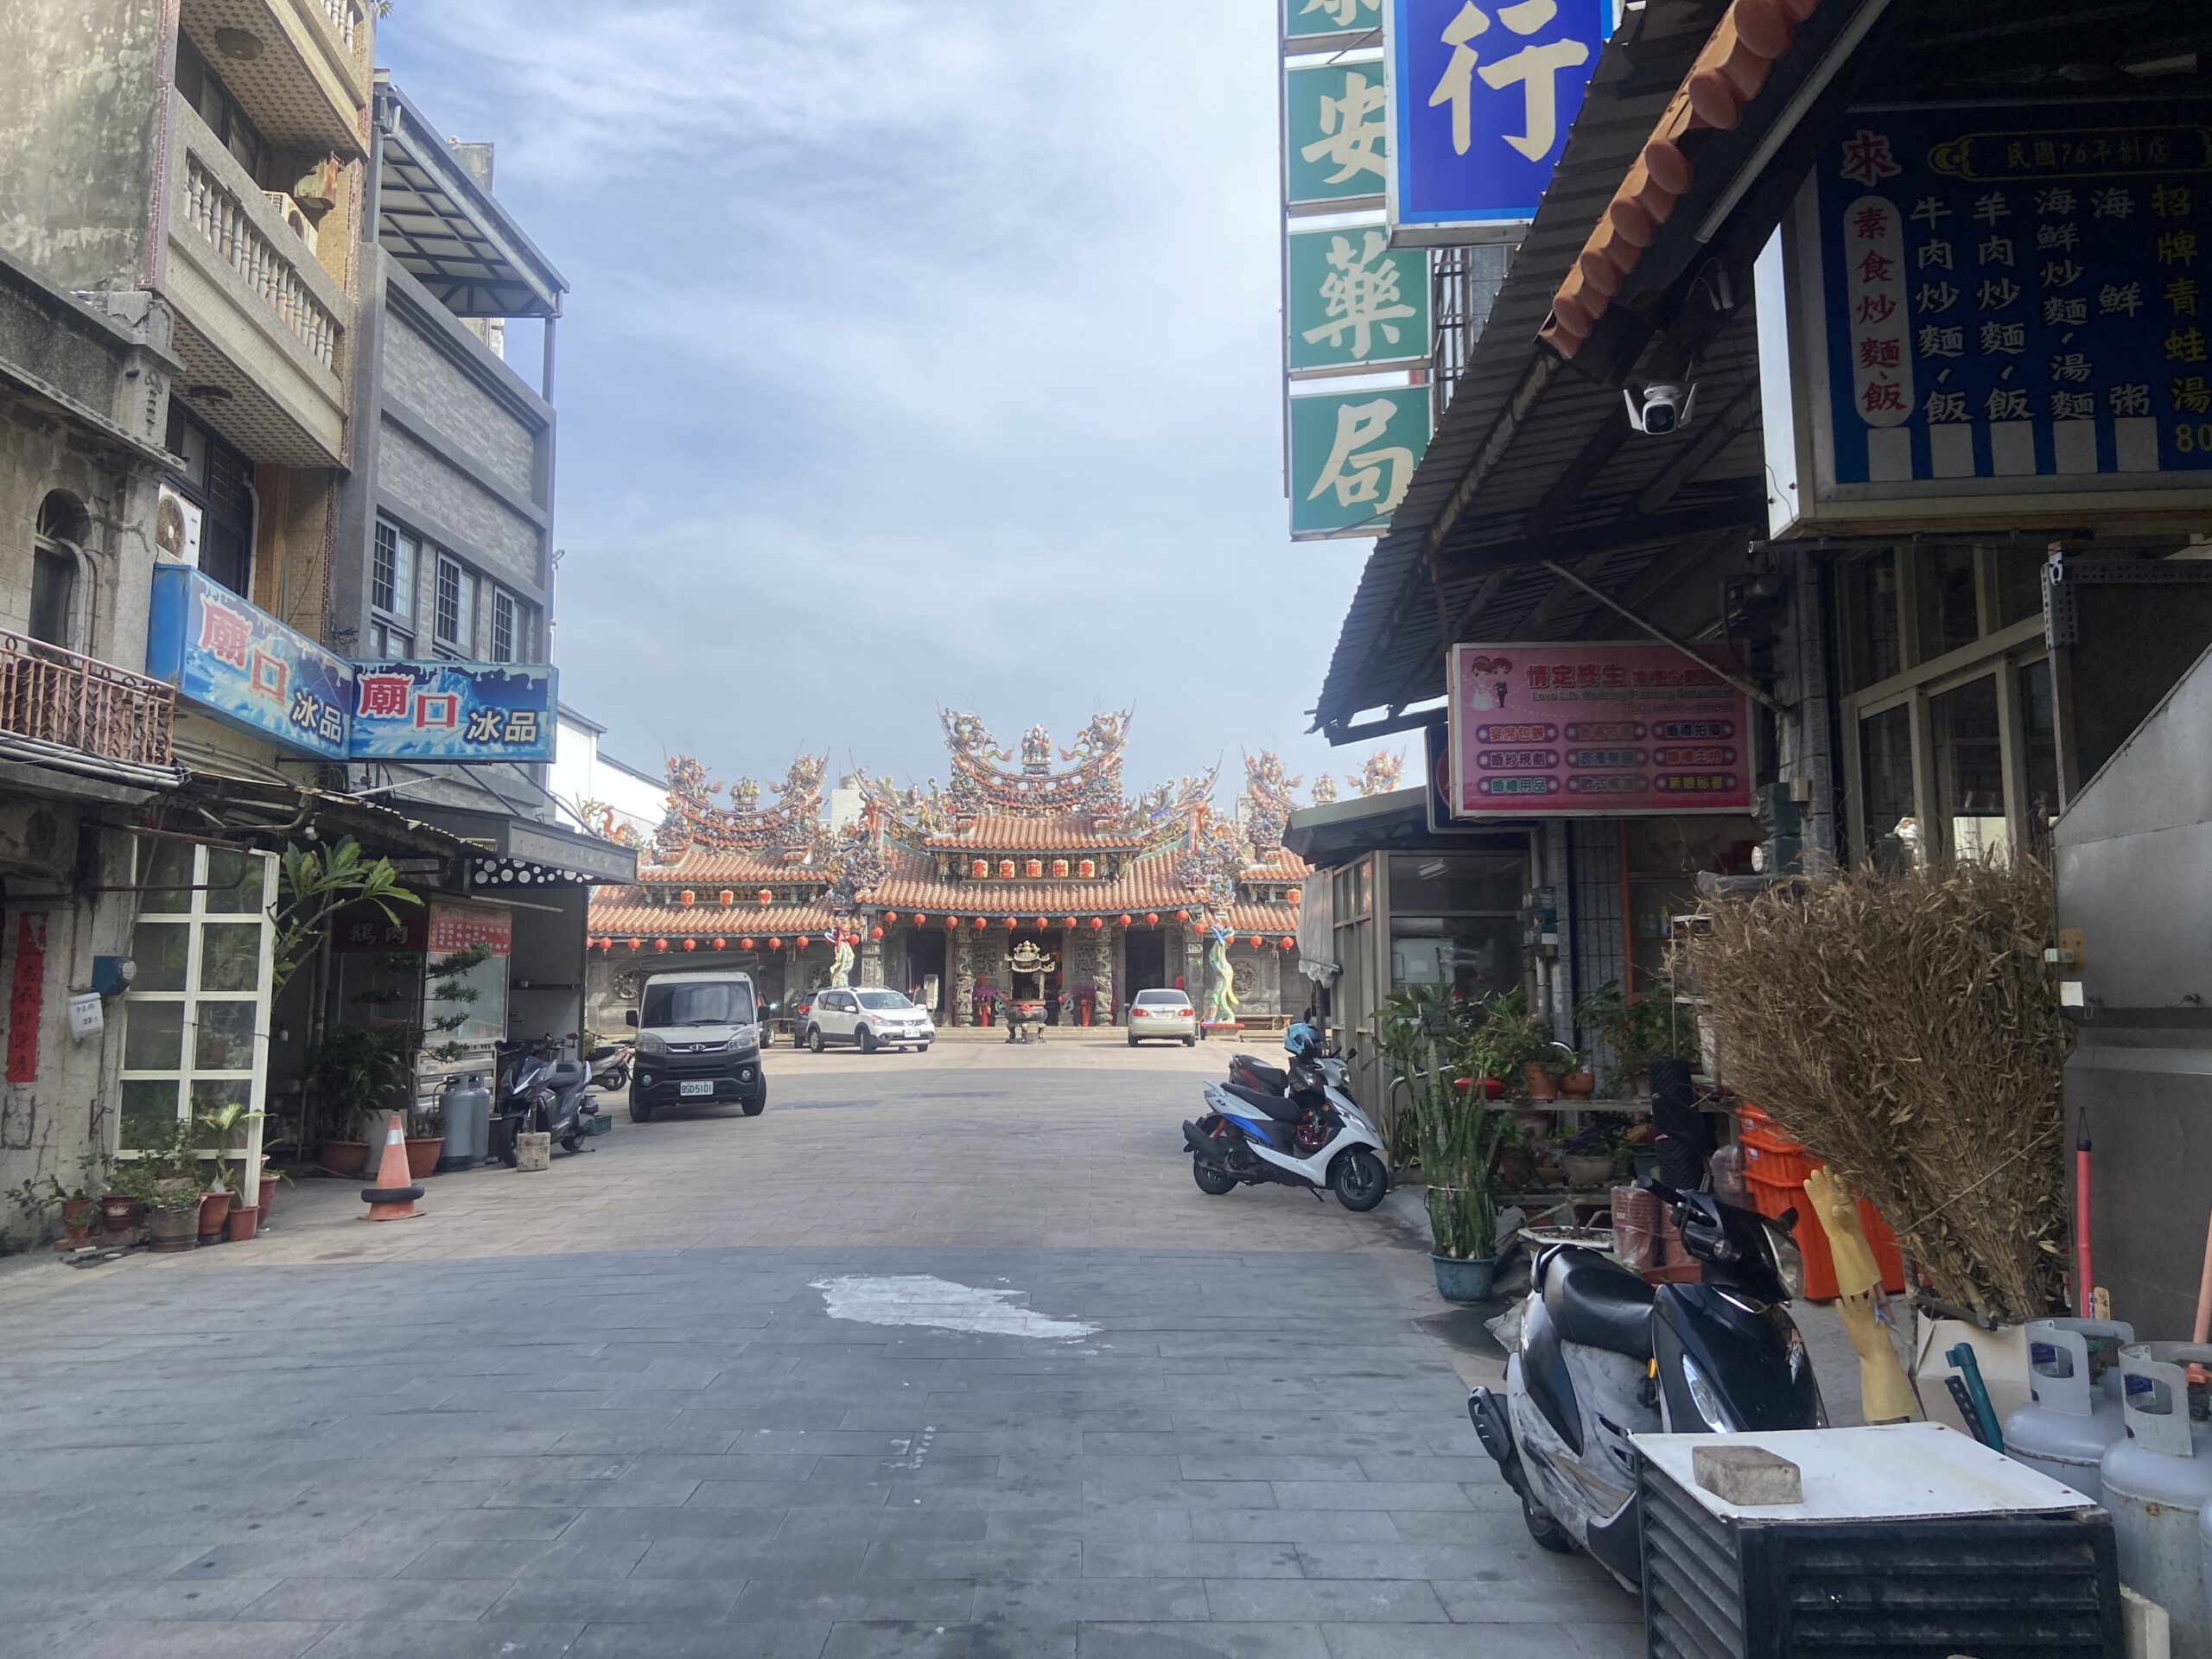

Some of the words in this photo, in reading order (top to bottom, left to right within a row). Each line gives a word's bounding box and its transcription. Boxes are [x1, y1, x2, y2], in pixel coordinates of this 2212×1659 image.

[1428, 0, 1590, 162] 行
[1843, 132, 1900, 184] 來
[2005, 138, 2172, 169] 民國76年創店
[1299, 0, 1415, 524] 安藥局
[2150, 183, 2211, 415] 招牌青蛙湯
[1532, 691, 1557, 701] Love
[1560, 691, 1577, 700] Life
[1580, 690, 1625, 702] Wedding
